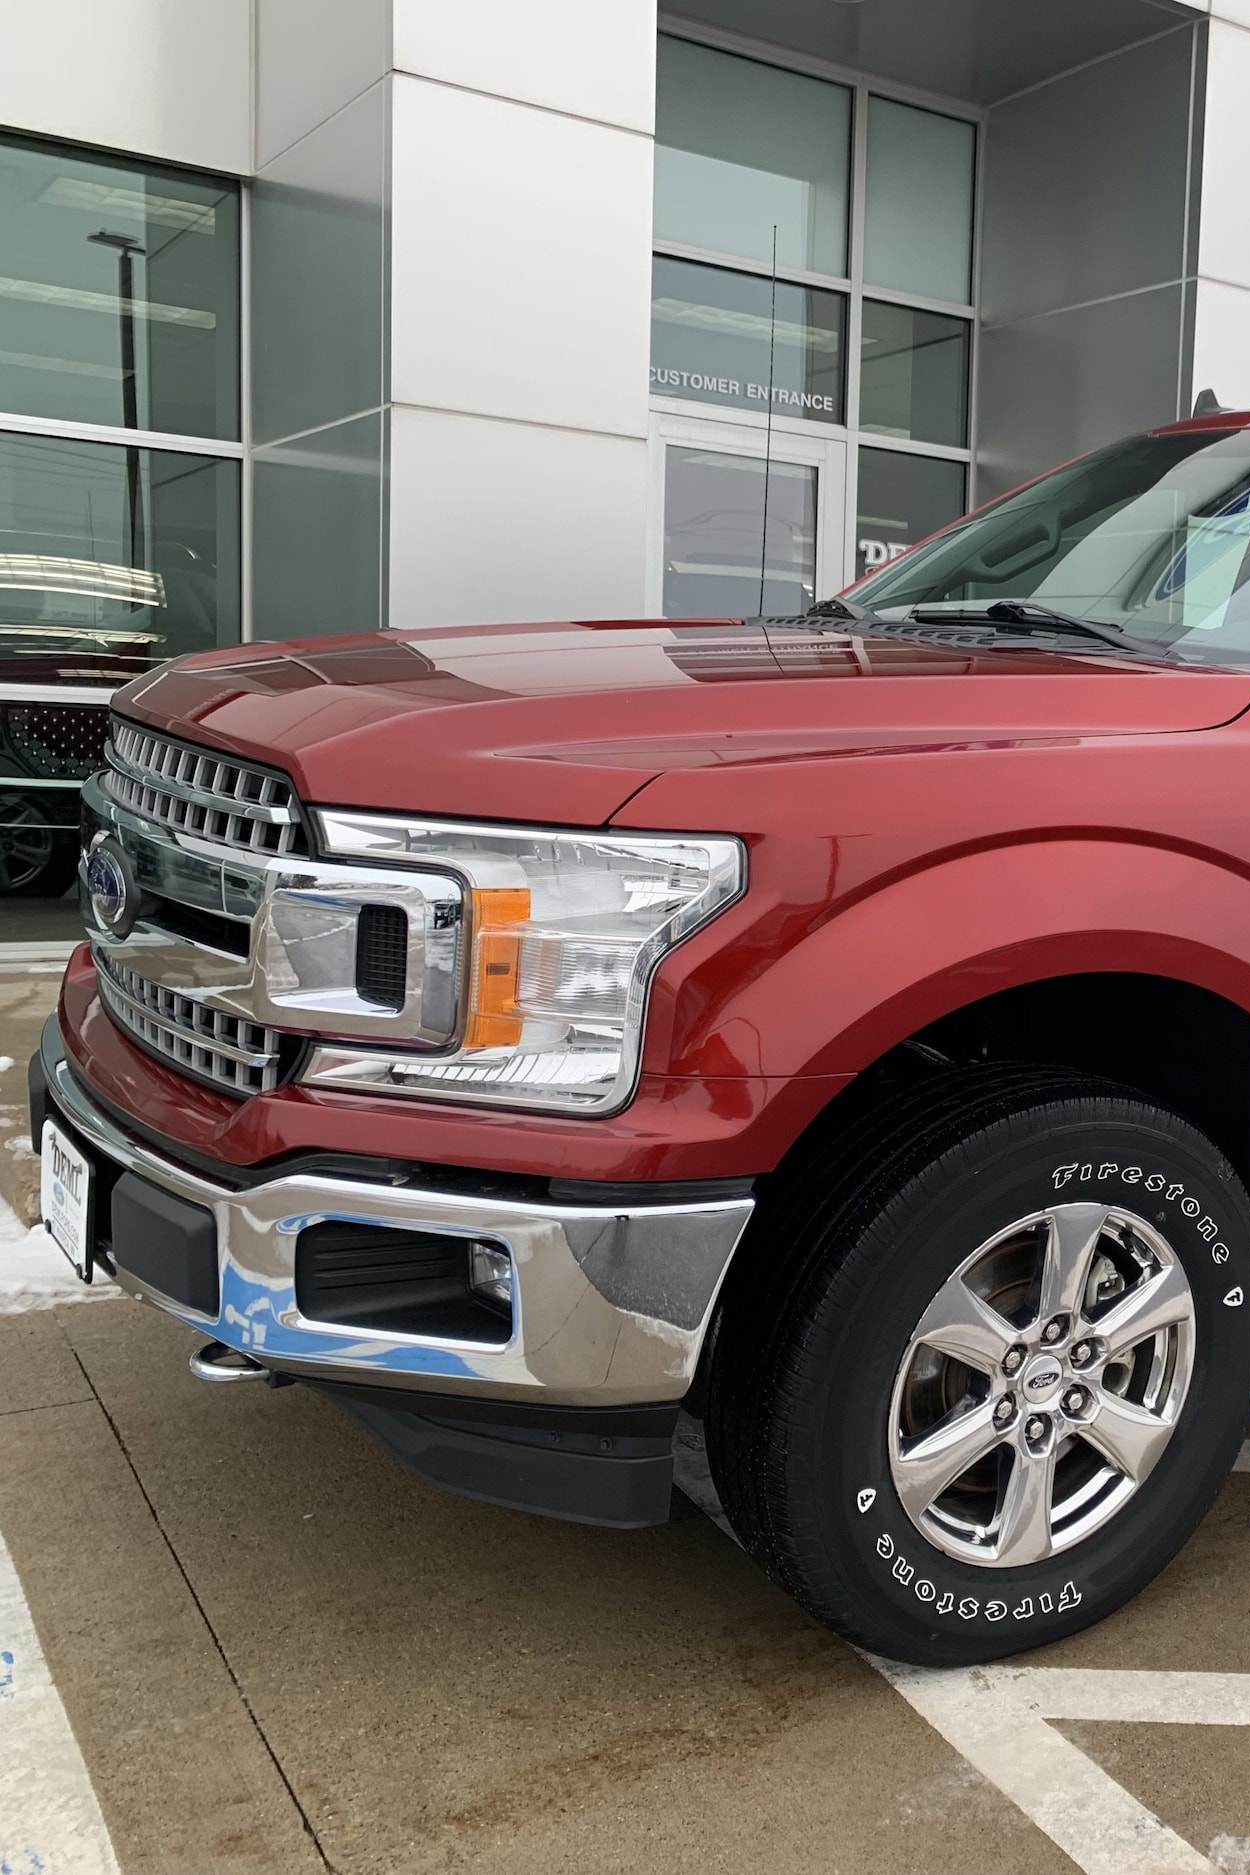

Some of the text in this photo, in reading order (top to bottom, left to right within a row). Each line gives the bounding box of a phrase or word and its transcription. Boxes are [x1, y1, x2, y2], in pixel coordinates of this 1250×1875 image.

[649, 366, 833, 411] CUSTOMER ENTRANCE
[1052, 1163, 1230, 1265] Firestone
[876, 1534, 1083, 1622] Firestone
